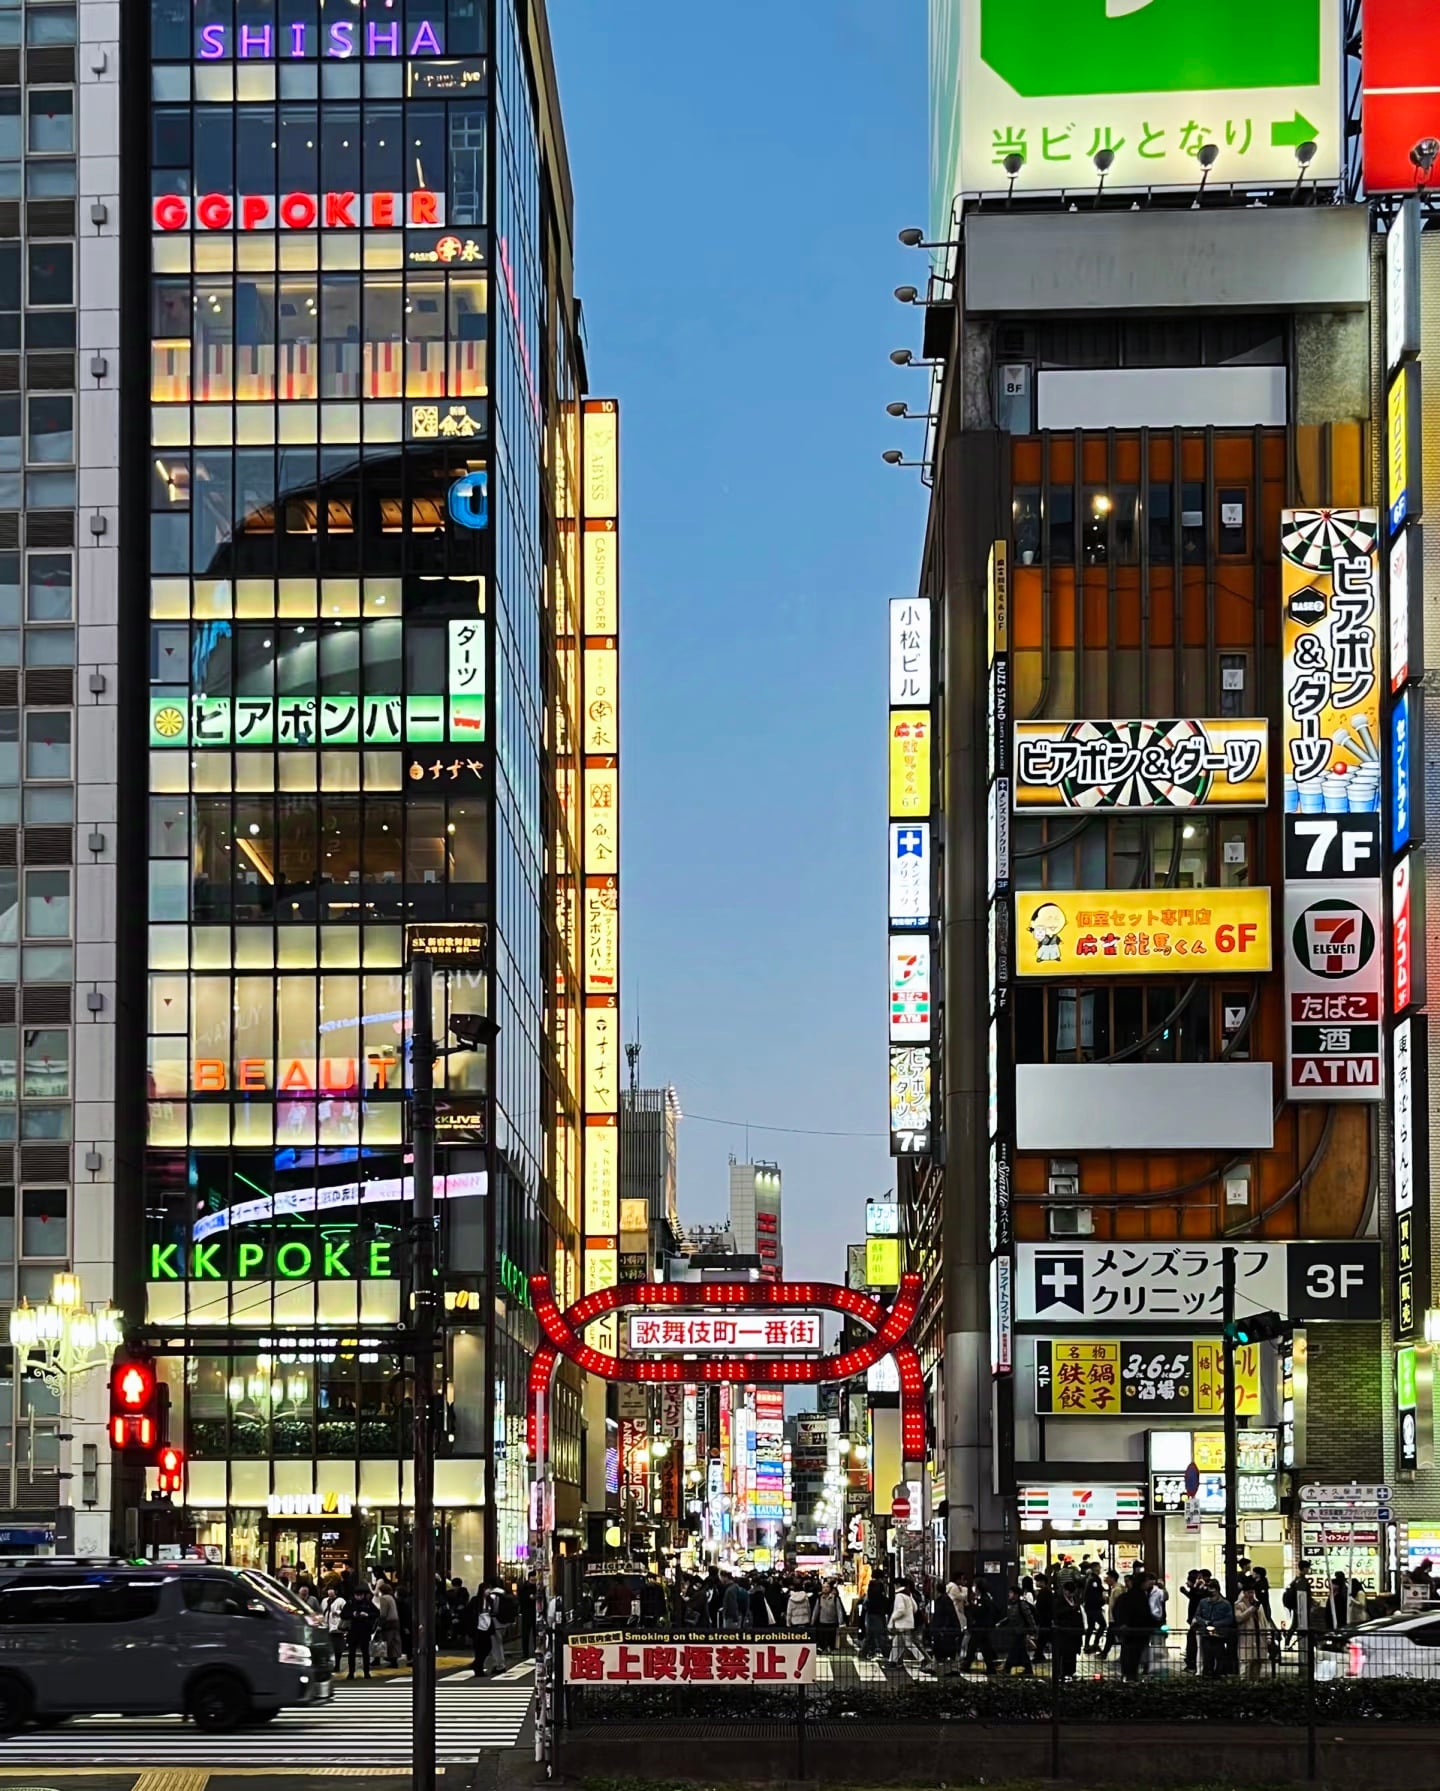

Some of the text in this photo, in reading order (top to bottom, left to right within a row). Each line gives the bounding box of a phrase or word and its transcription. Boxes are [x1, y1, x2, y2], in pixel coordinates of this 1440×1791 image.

[201, 20, 442, 59] SHISHA
[992, 118, 1253, 164] 当ビルとなり
[153, 191, 440, 231] GGPOKER
[1006, 382, 1023, 393] 8F
[601, 401, 613, 413] 10
[591, 455, 603, 502] ABYSS
[605, 519, 613, 531] 9
[594, 537, 606, 630] CASINO POKER
[605, 638, 613, 649] 8
[1331, 557, 1376, 708] ビアポン
[456, 624, 478, 687] ダーツ
[899, 605, 921, 698] 小松ビル
[996, 661, 1007, 720] BUZZ STAND
[195, 700, 440, 740] ビアポンバー
[605, 757, 613, 768] 7
[1018, 739, 1261, 787] ビアポン&ダーツ
[1294, 820, 1374, 873] 7F
[606, 876, 615, 888] 6
[1075, 908, 1211, 929] 個室セット専門店
[1075, 932, 1208, 956] 麻雀龍馬くん
[1214, 922, 1258, 954] 6F
[606, 996, 615, 1008] 5
[1300, 995, 1370, 1019] たばこ
[1318, 1027, 1352, 1051] 酒
[194, 1057, 440, 1092] BEAUT
[1298, 1060, 1373, 1084] ATM
[606, 1115, 615, 1126] 4
[896, 1130, 927, 1152] 7F
[606, 1237, 615, 1249] 3
[151, 1242, 437, 1278] KKPOKE
[1305, 1264, 1365, 1299] 3F
[636, 1319, 814, 1346] 歌舞伎町一番街
[1068, 1346, 1107, 1360] 名物
[1038, 1365, 1051, 1388] 2F
[1057, 1363, 1116, 1386] 鉄鍋
[1199, 1356, 1212, 1397] 格安
[1057, 1386, 1116, 1410] 餃子
[1137, 1380, 1176, 1401] 酒場
[624, 1632, 812, 1644] Smoking on the street is prohibited.
[569, 1645, 812, 1681] 路上喫煙禁止!
